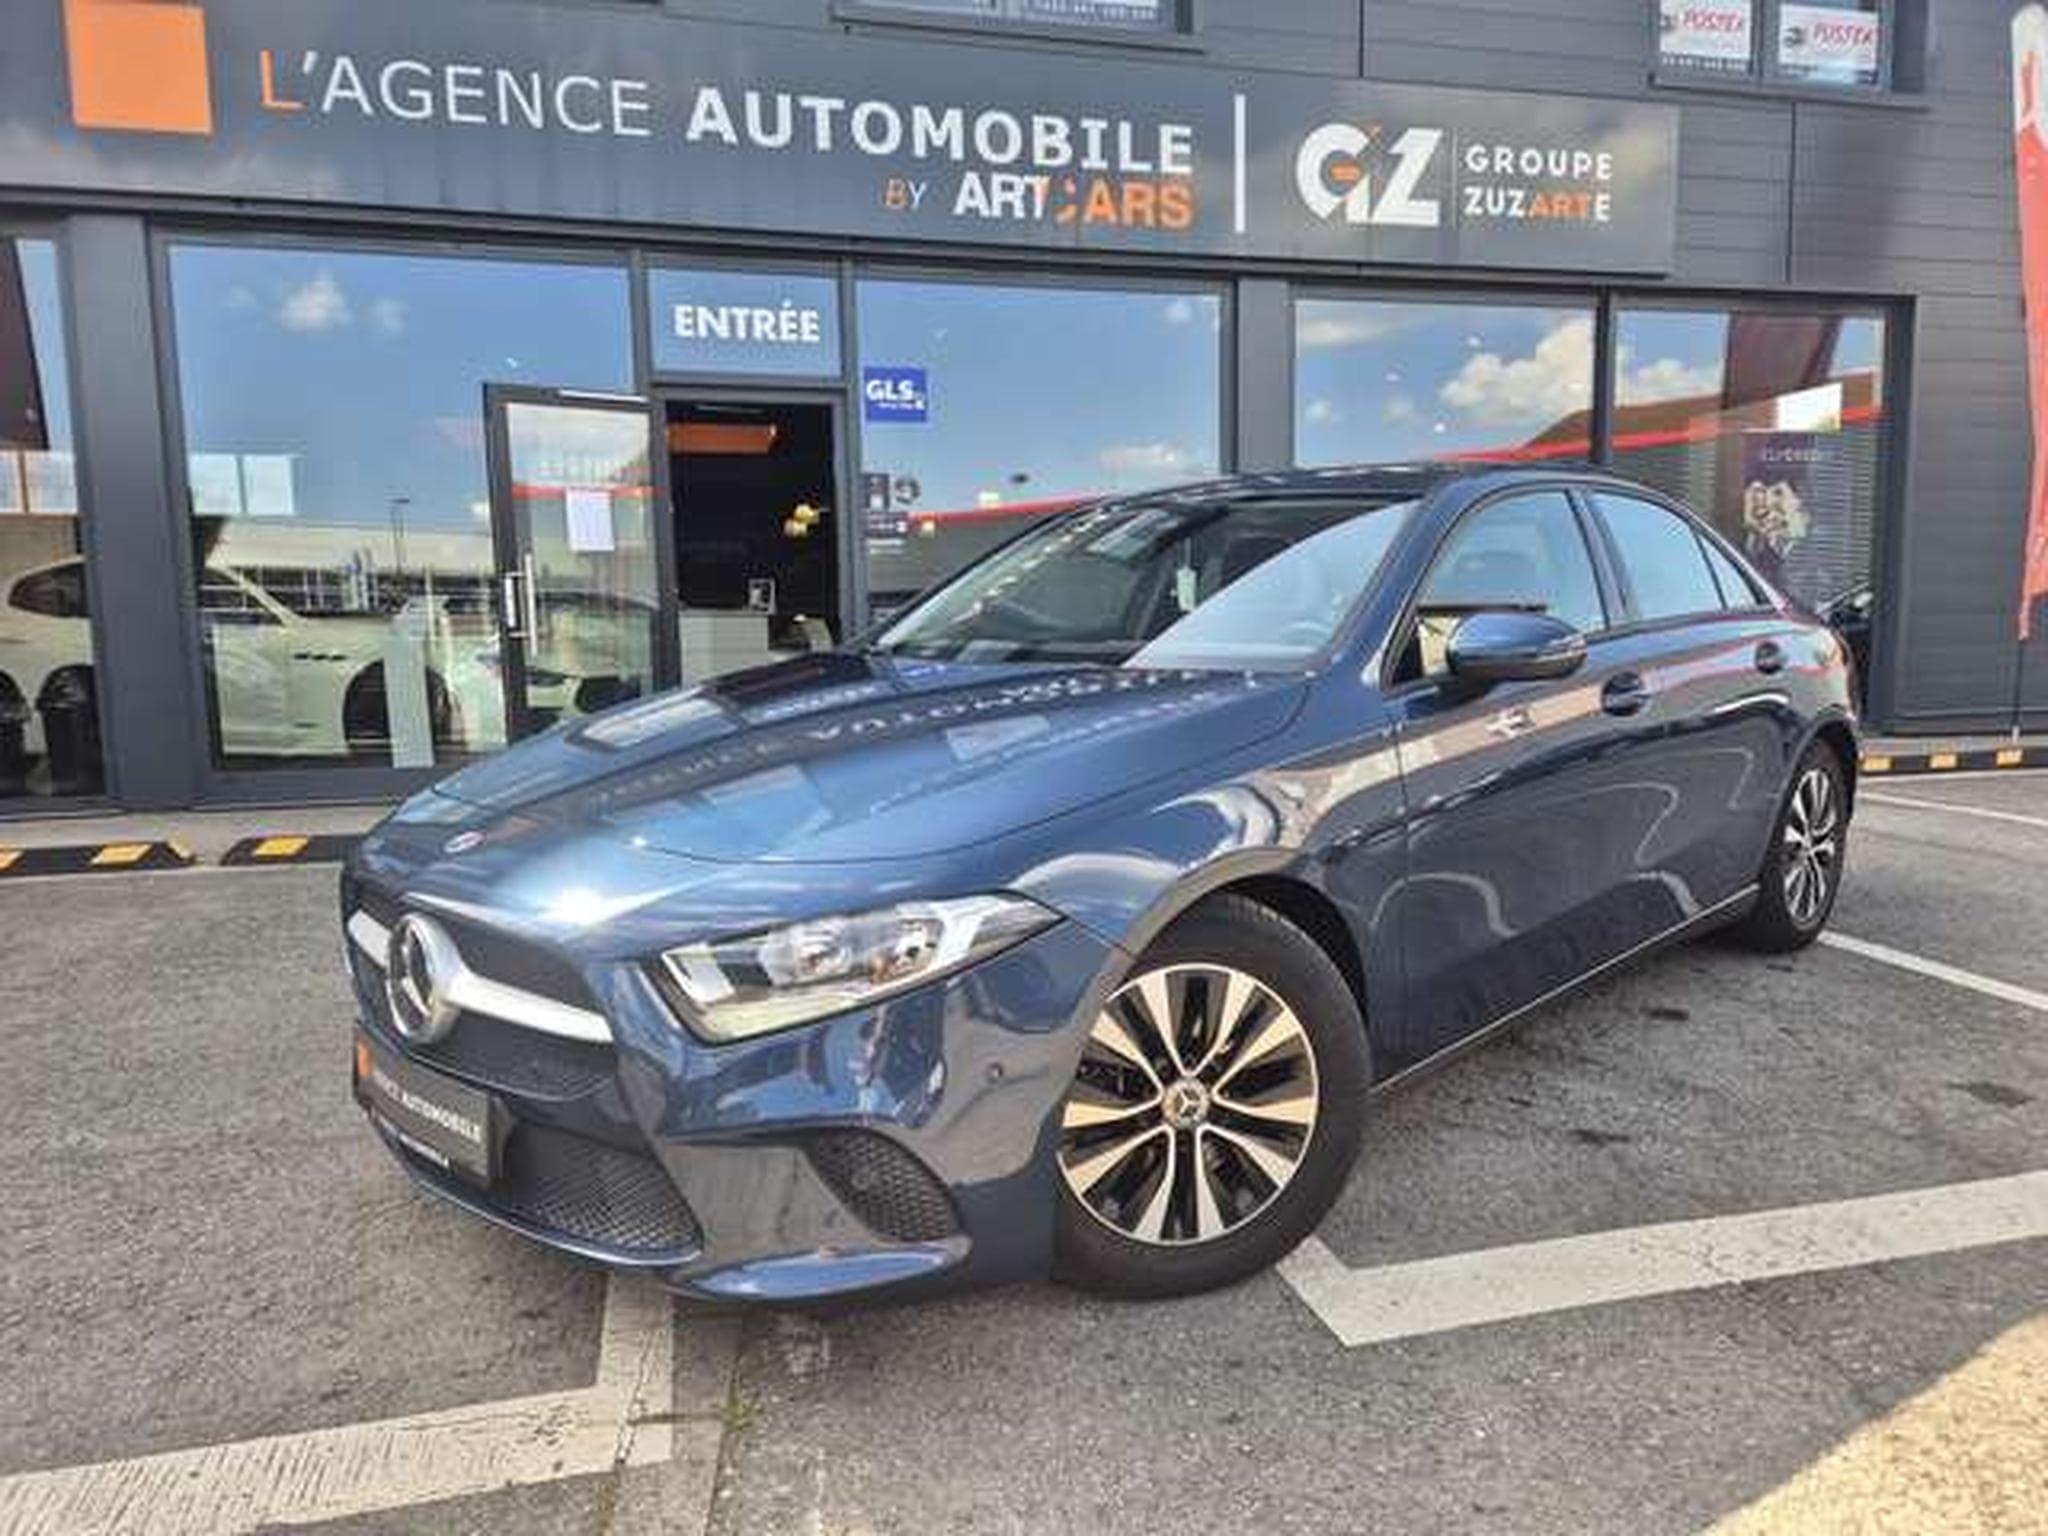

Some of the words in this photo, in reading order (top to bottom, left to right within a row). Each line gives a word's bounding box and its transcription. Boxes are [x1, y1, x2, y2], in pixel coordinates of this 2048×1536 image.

[259, 50, 652, 137] L'AGENCE
[685, 87, 1193, 174] AUTOMOBILE
[1464, 144, 1613, 180] GROUPE
[885, 177, 927, 210] BY
[1464, 185, 1612, 222] ZUZARTE
[674, 300, 820, 343] ENTRÉE
[866, 379, 914, 401] GLS
[401, 1089, 482, 1144] AUTOMOBILE
